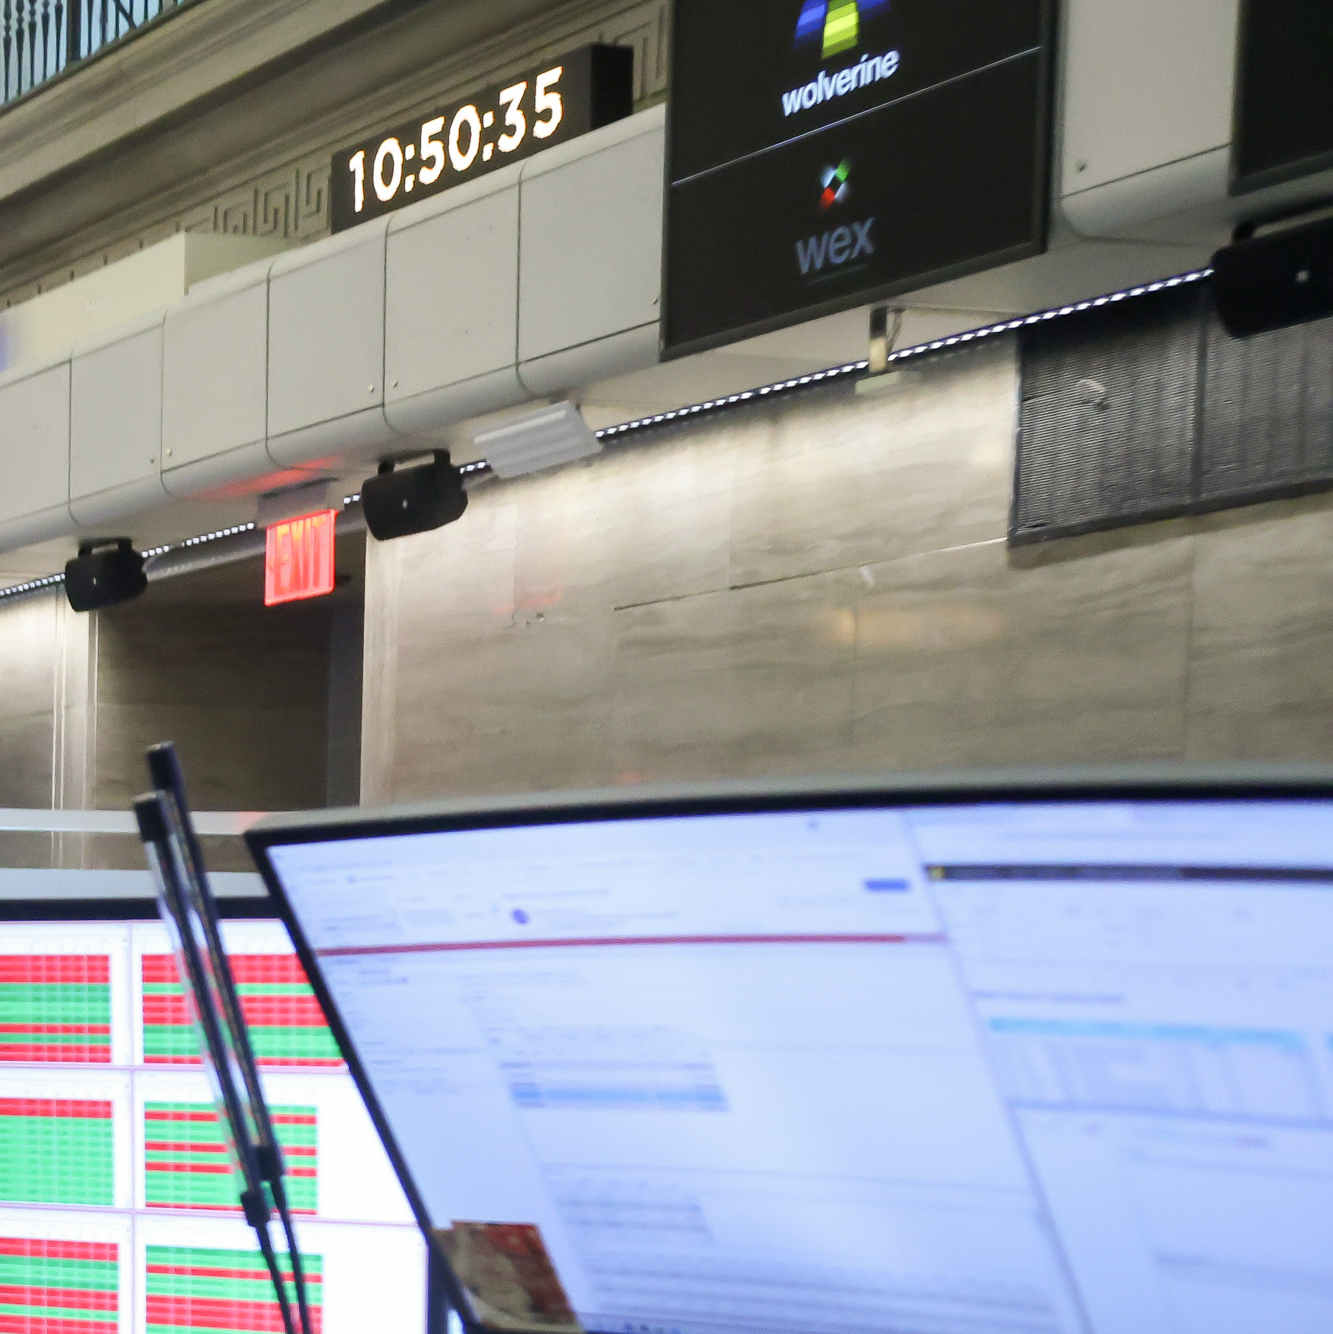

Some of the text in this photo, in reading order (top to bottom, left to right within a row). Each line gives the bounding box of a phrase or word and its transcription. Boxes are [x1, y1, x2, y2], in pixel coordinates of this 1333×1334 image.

[782, 49, 900, 117] wolverine
[348, 66, 565, 212] 10:50:35
[795, 216, 875, 275] wex
[276, 516, 327, 596] EXIT
